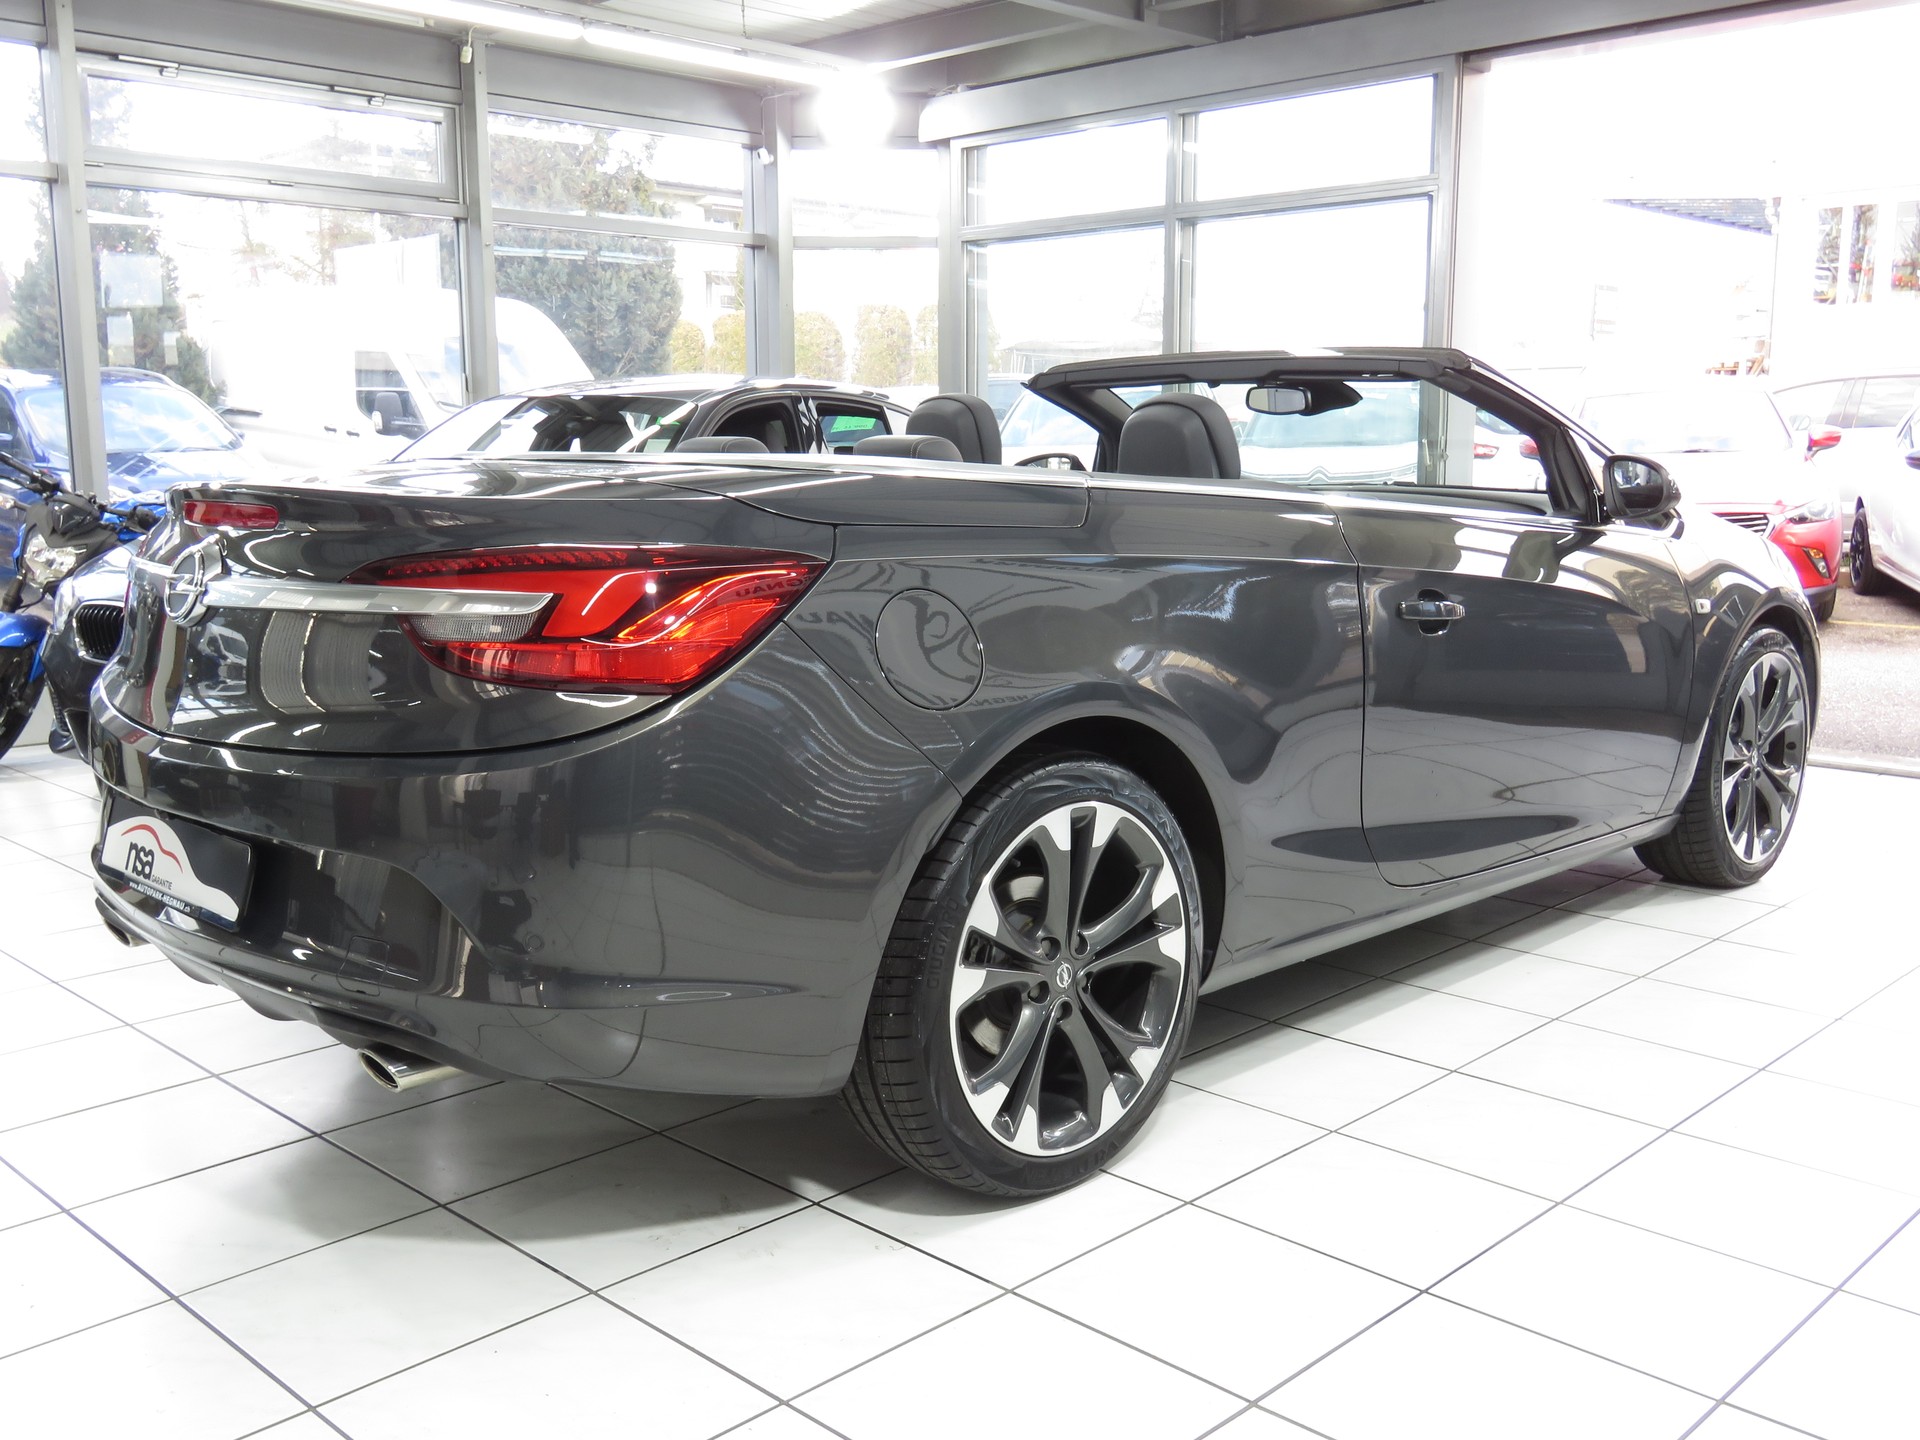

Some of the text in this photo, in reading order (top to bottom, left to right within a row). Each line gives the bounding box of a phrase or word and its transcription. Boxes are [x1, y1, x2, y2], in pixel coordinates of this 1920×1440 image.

[125, 842, 154, 881] nsa
[129, 881, 191, 913] www.AUTOPARK-HEGNAU.ch
[151, 874, 173, 891] GARANTIE
[926, 897, 958, 990] GIUGIARO
